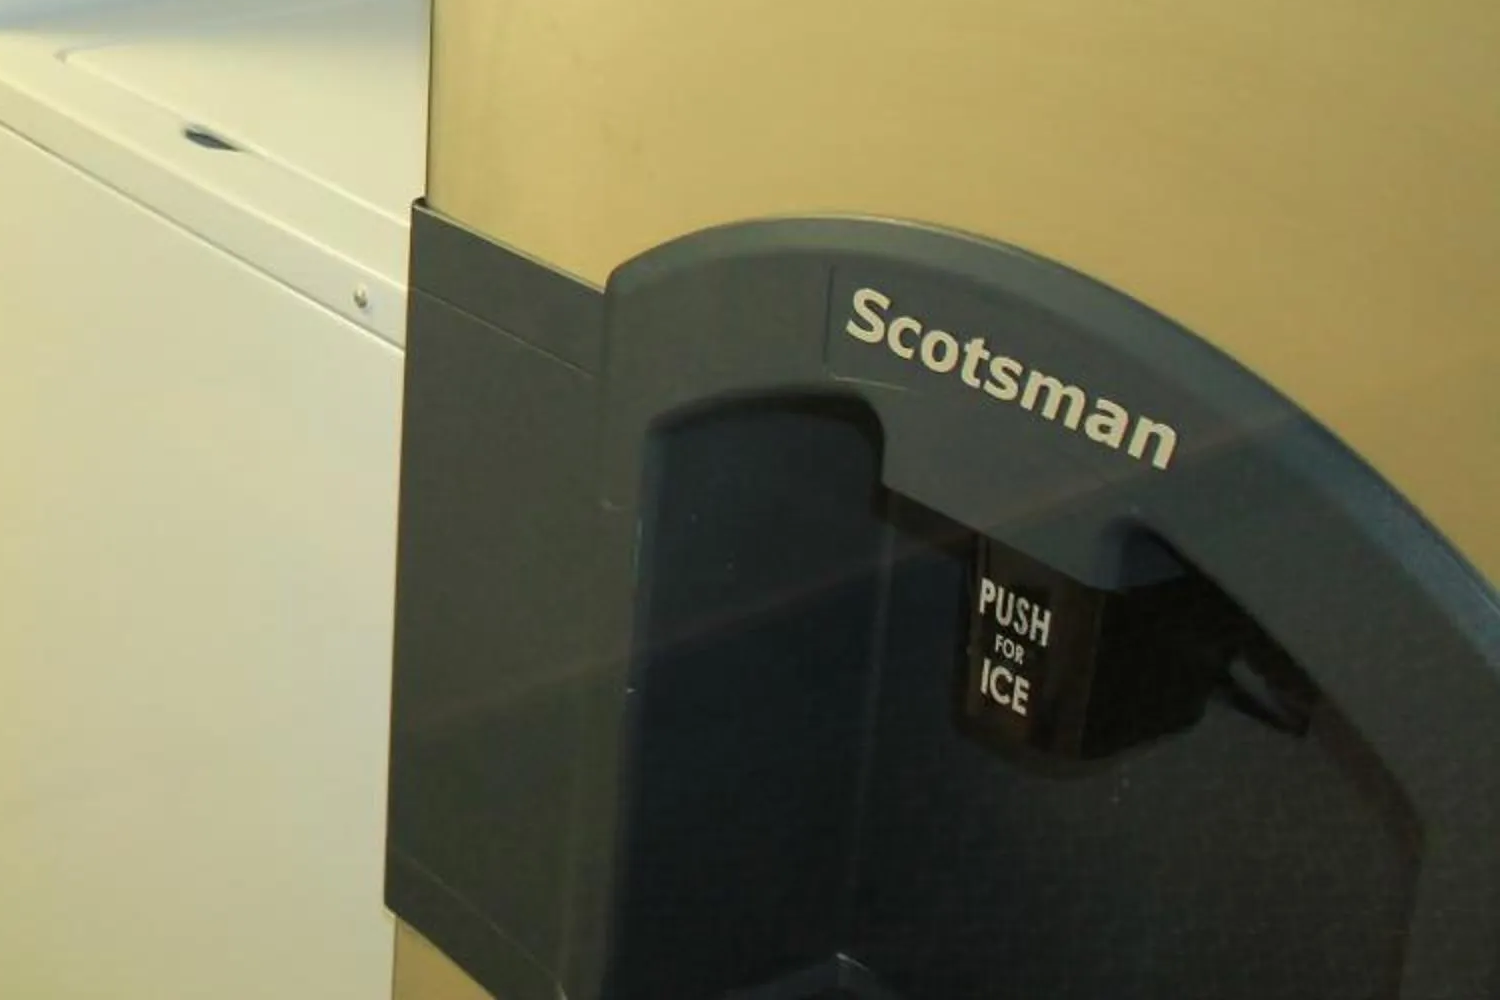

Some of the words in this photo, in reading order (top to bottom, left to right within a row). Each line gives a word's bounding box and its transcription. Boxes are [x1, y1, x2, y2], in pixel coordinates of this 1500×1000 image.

[846, 287, 1178, 470] Scotsman
[979, 577, 1052, 647] PUSH
[995, 634, 1025, 665] FOR
[980, 658, 1031, 717] ICE
